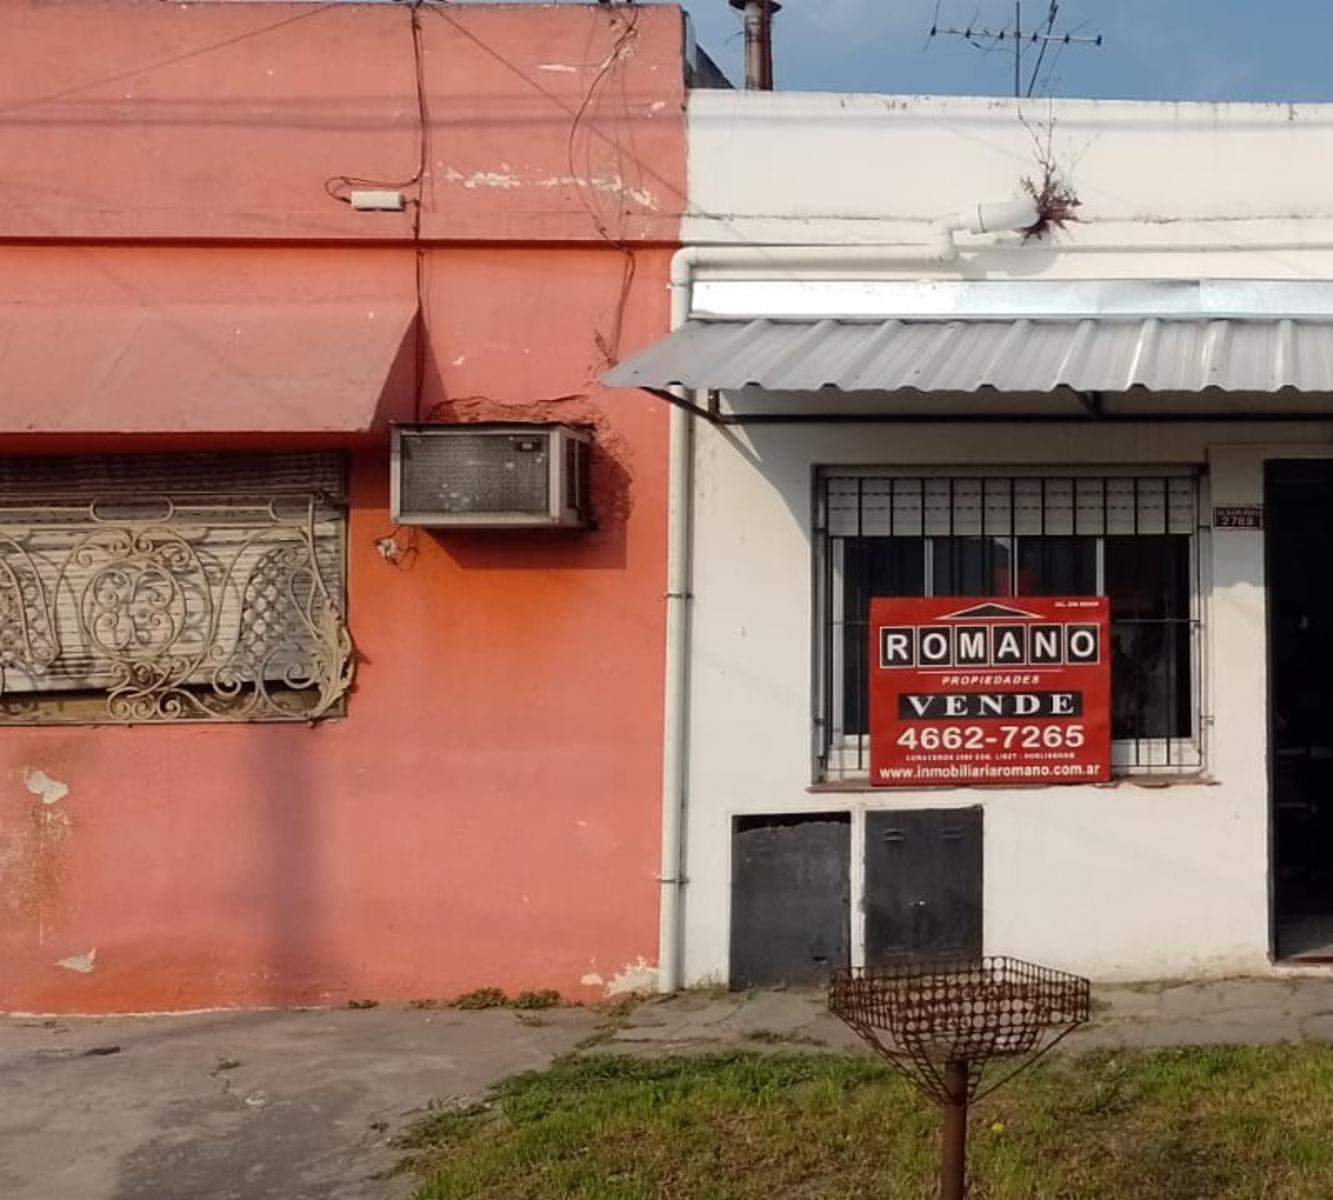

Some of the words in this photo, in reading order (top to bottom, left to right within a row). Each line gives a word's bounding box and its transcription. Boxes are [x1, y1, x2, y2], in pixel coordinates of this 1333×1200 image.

[886, 630, 1095, 661] ROMANO
[941, 675, 1041, 686] PROPIEDADES
[906, 694, 1075, 717] VENDE
[896, 725, 1085, 750] 4662-7265
[879, 764, 1101, 780] www.inmobiliariaromano.com.ar
